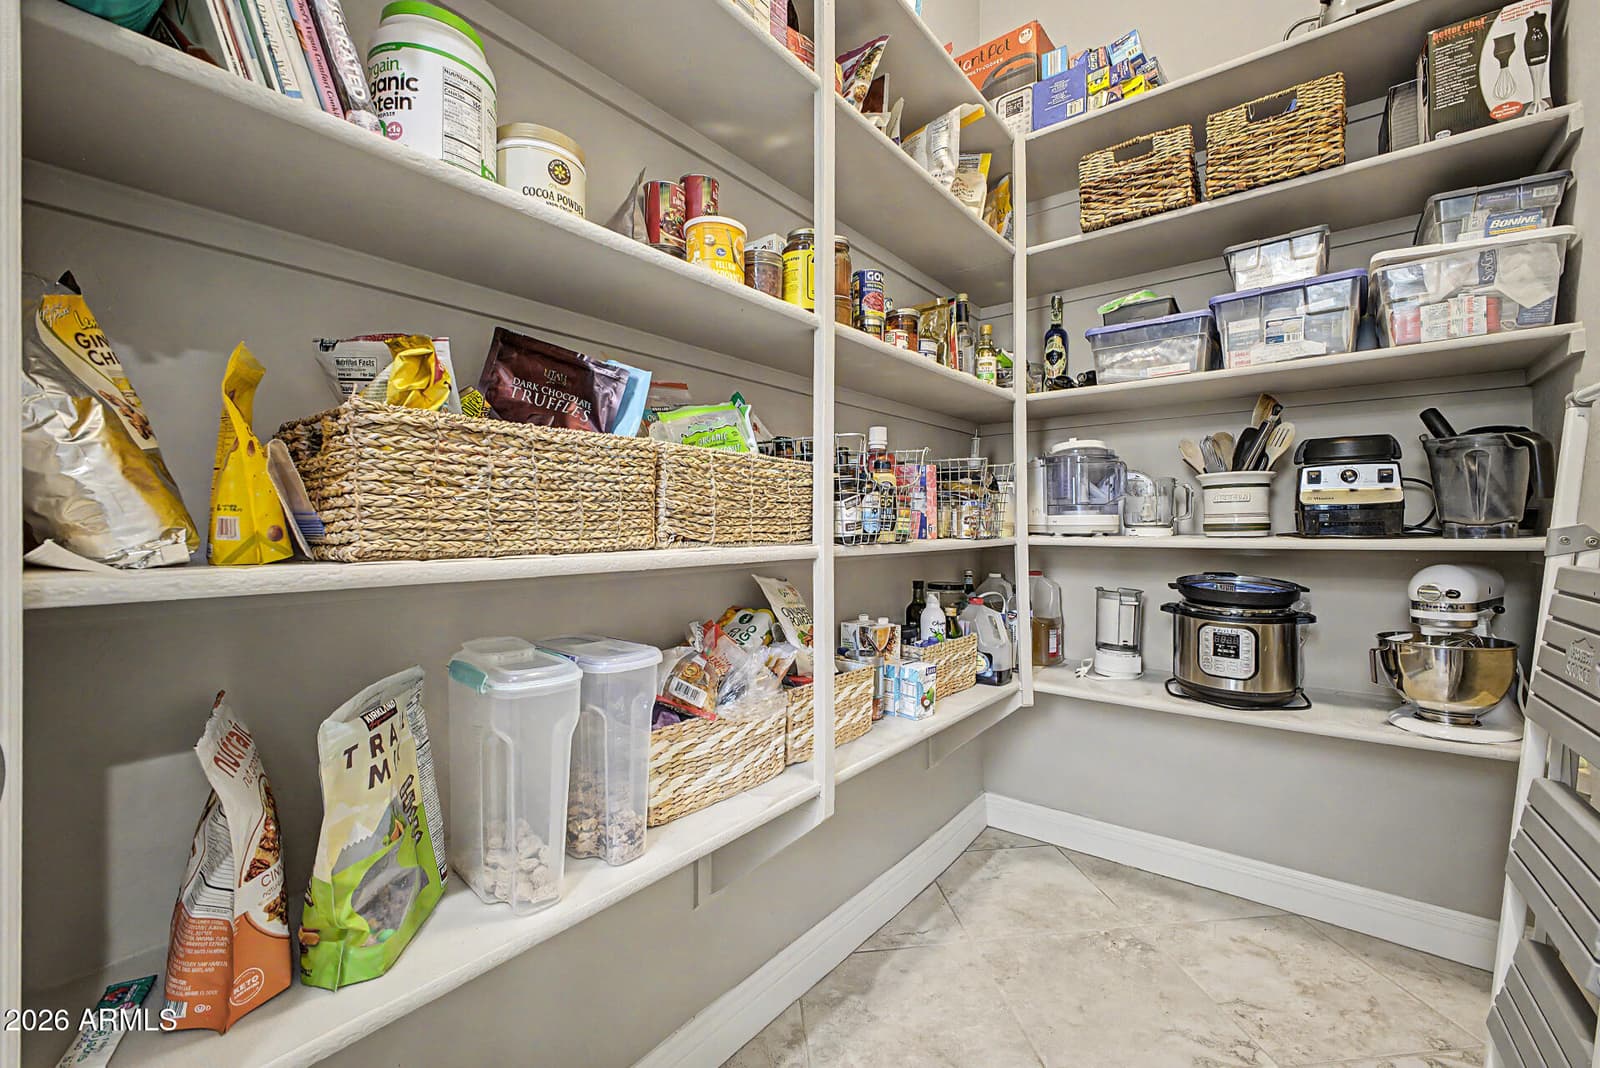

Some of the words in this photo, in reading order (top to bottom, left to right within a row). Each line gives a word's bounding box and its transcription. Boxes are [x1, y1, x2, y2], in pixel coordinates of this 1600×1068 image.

[370, 72, 419, 99] ganic
[373, 91, 413, 112] tein
[522, 185, 555, 201] COCOA
[510, 384, 592, 423] TRUFFLES
[512, 377, 539, 392] DARK
[541, 386, 593, 411] CHOCOLATE
[364, 700, 396, 724] KIRKLAND
[233, 974, 259, 995] KETO
